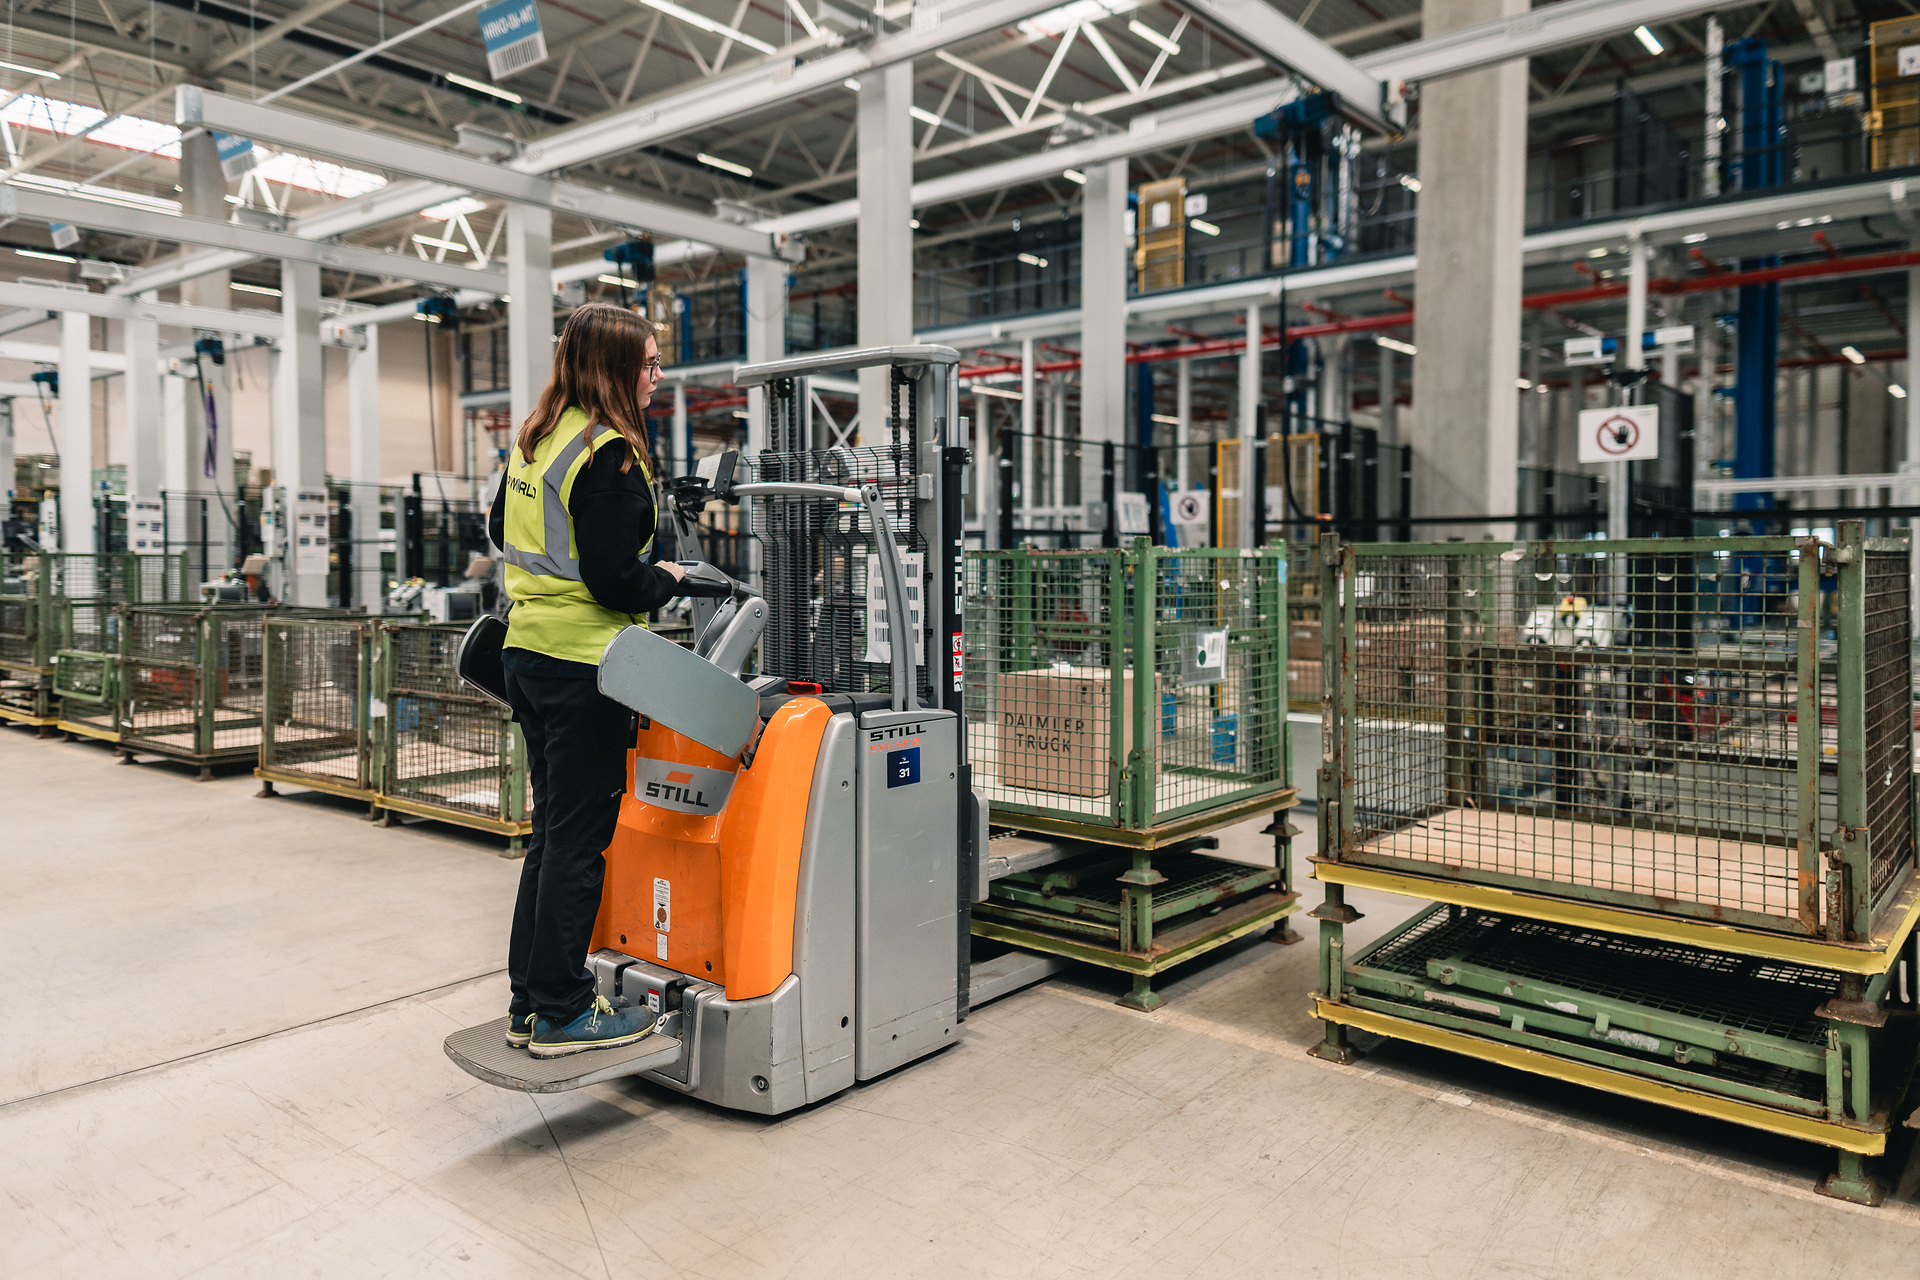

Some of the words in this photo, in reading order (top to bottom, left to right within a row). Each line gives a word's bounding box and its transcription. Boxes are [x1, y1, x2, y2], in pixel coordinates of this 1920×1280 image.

[954, 530, 963, 615] STILL
[870, 724, 927, 742] STILL
[1004, 712, 1085, 735] DAIMLER
[1016, 733, 1072, 753] TRUCK
[898, 767, 911, 779] 31
[645, 781, 710, 808] STILL
